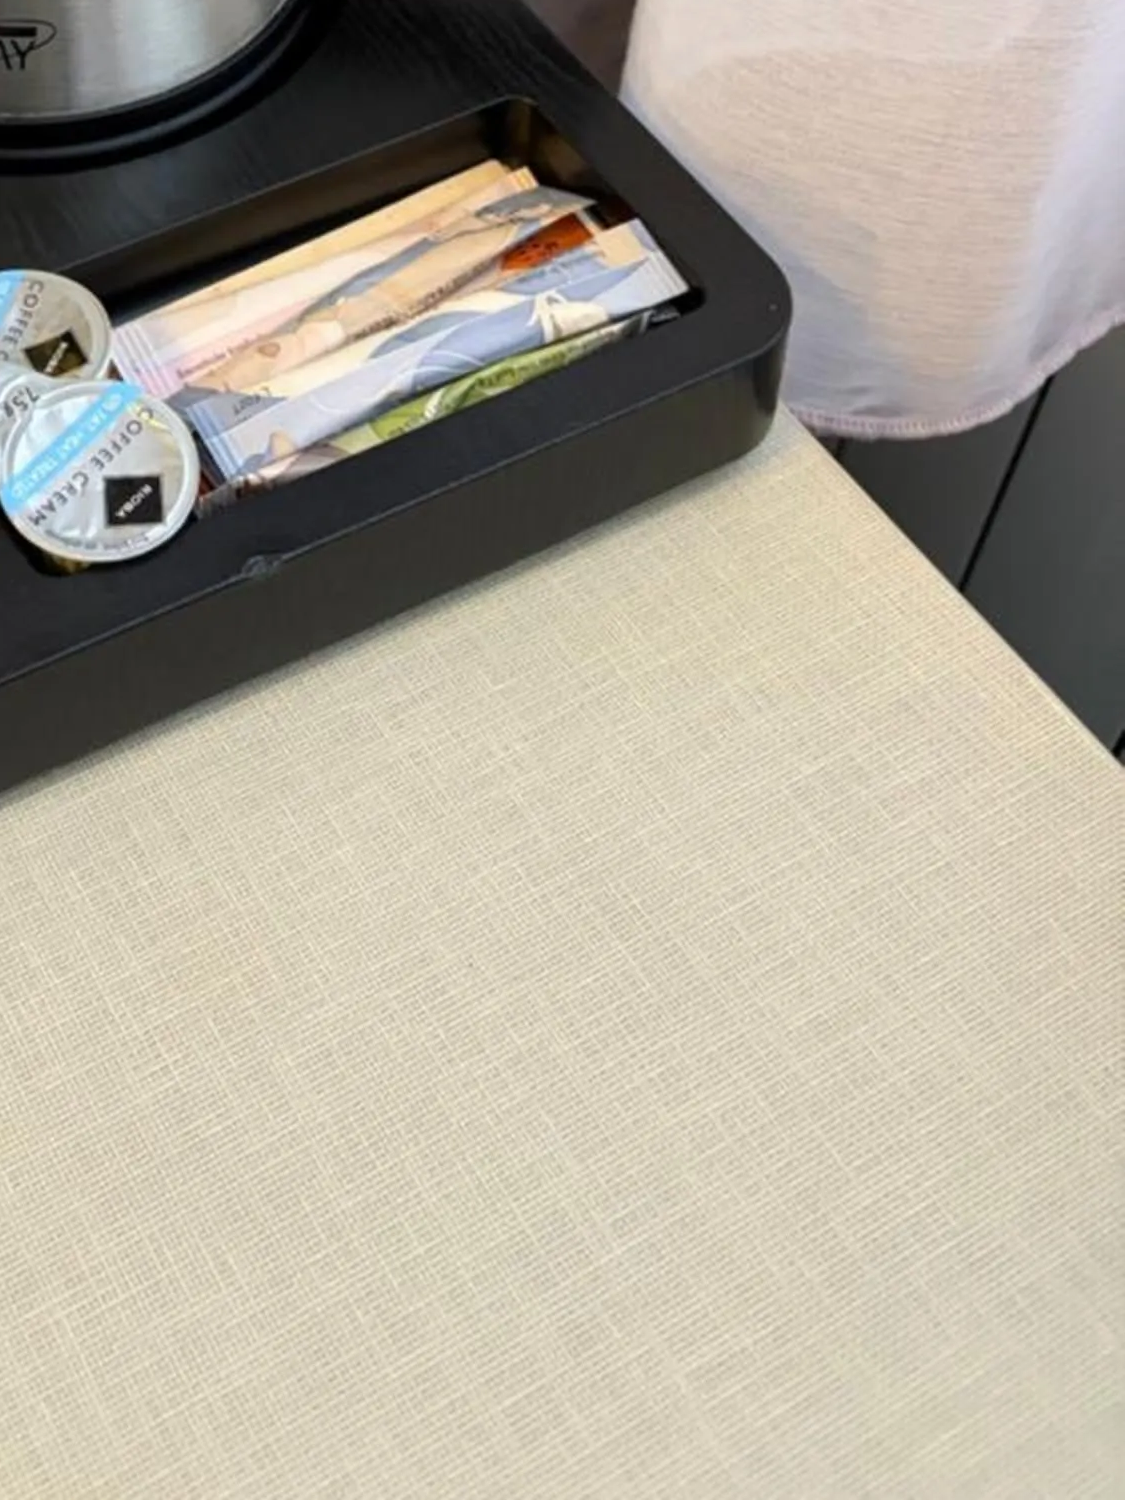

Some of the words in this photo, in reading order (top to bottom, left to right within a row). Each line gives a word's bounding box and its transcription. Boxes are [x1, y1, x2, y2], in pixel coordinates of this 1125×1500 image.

[3, 279, 44, 343] COFFEE
[91, 407, 154, 471] COFFEE
[28, 471, 90, 527] CREAM
